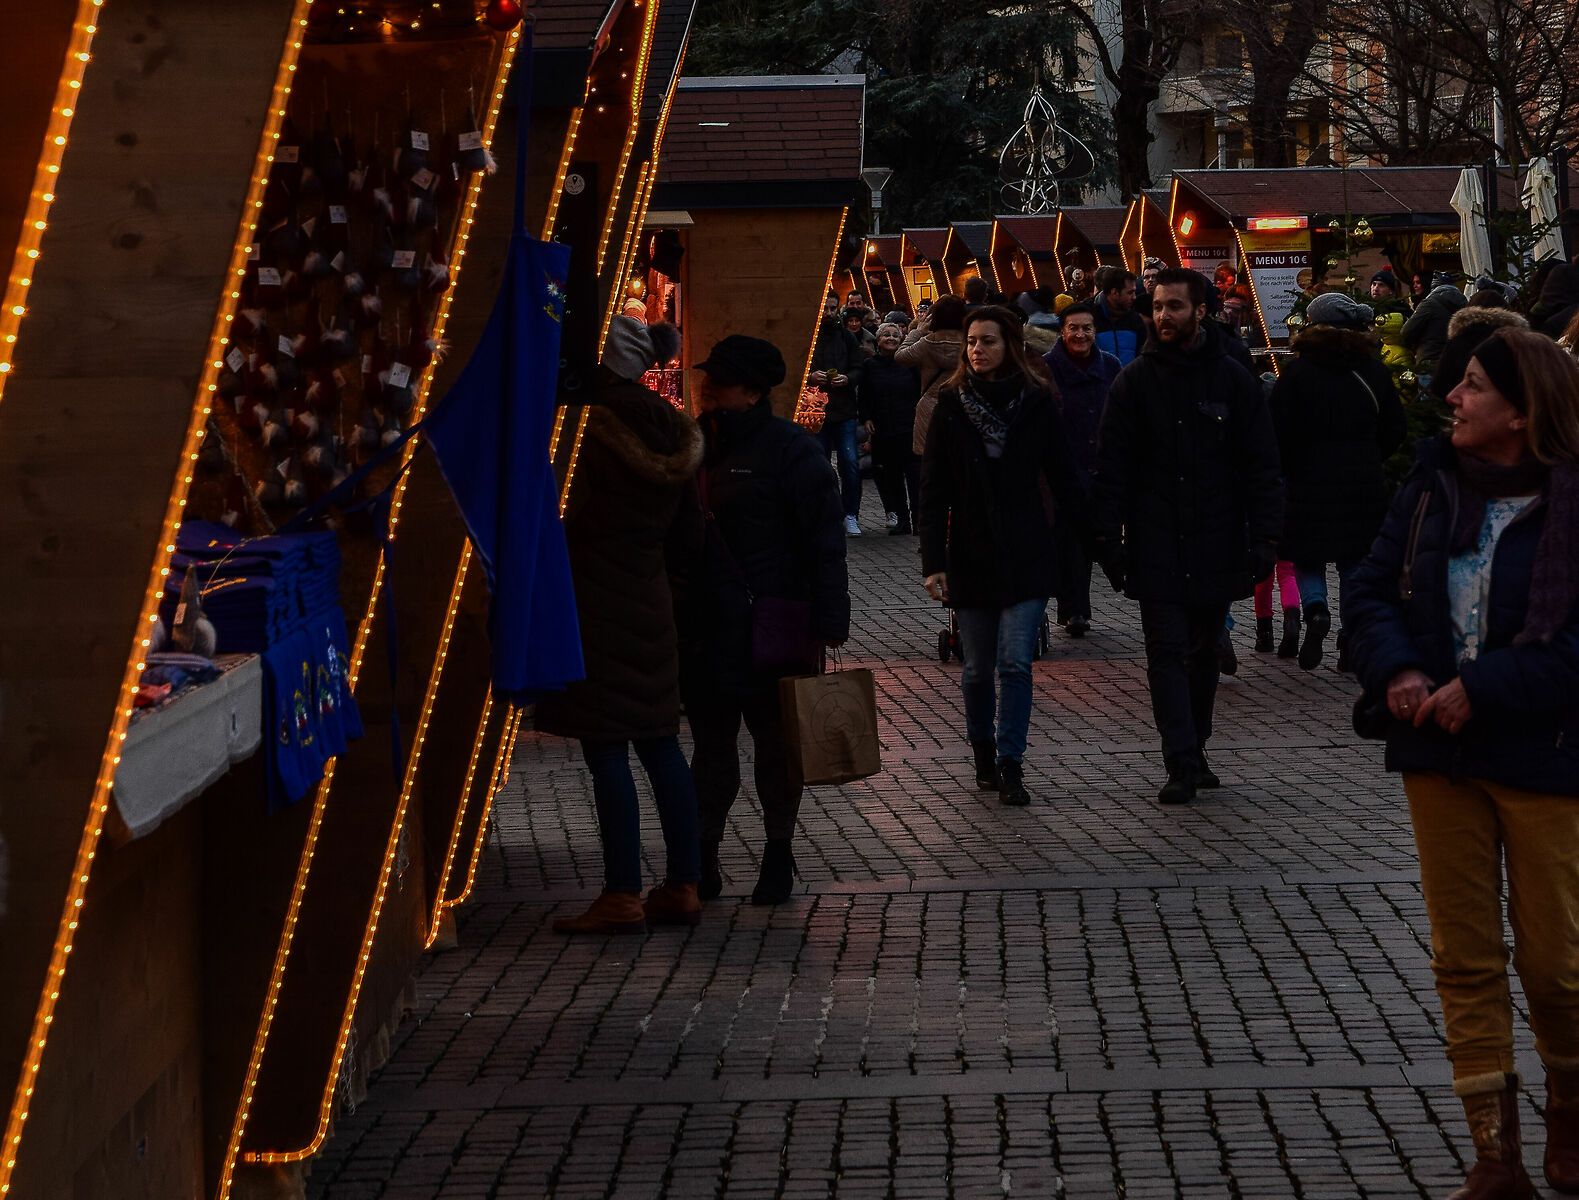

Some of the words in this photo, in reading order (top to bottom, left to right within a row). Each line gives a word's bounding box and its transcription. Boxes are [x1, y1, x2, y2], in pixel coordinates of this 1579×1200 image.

[1186, 249, 1210, 257] MENU
[1256, 256, 1285, 265] MENU
[1289, 256, 1300, 264] 10
